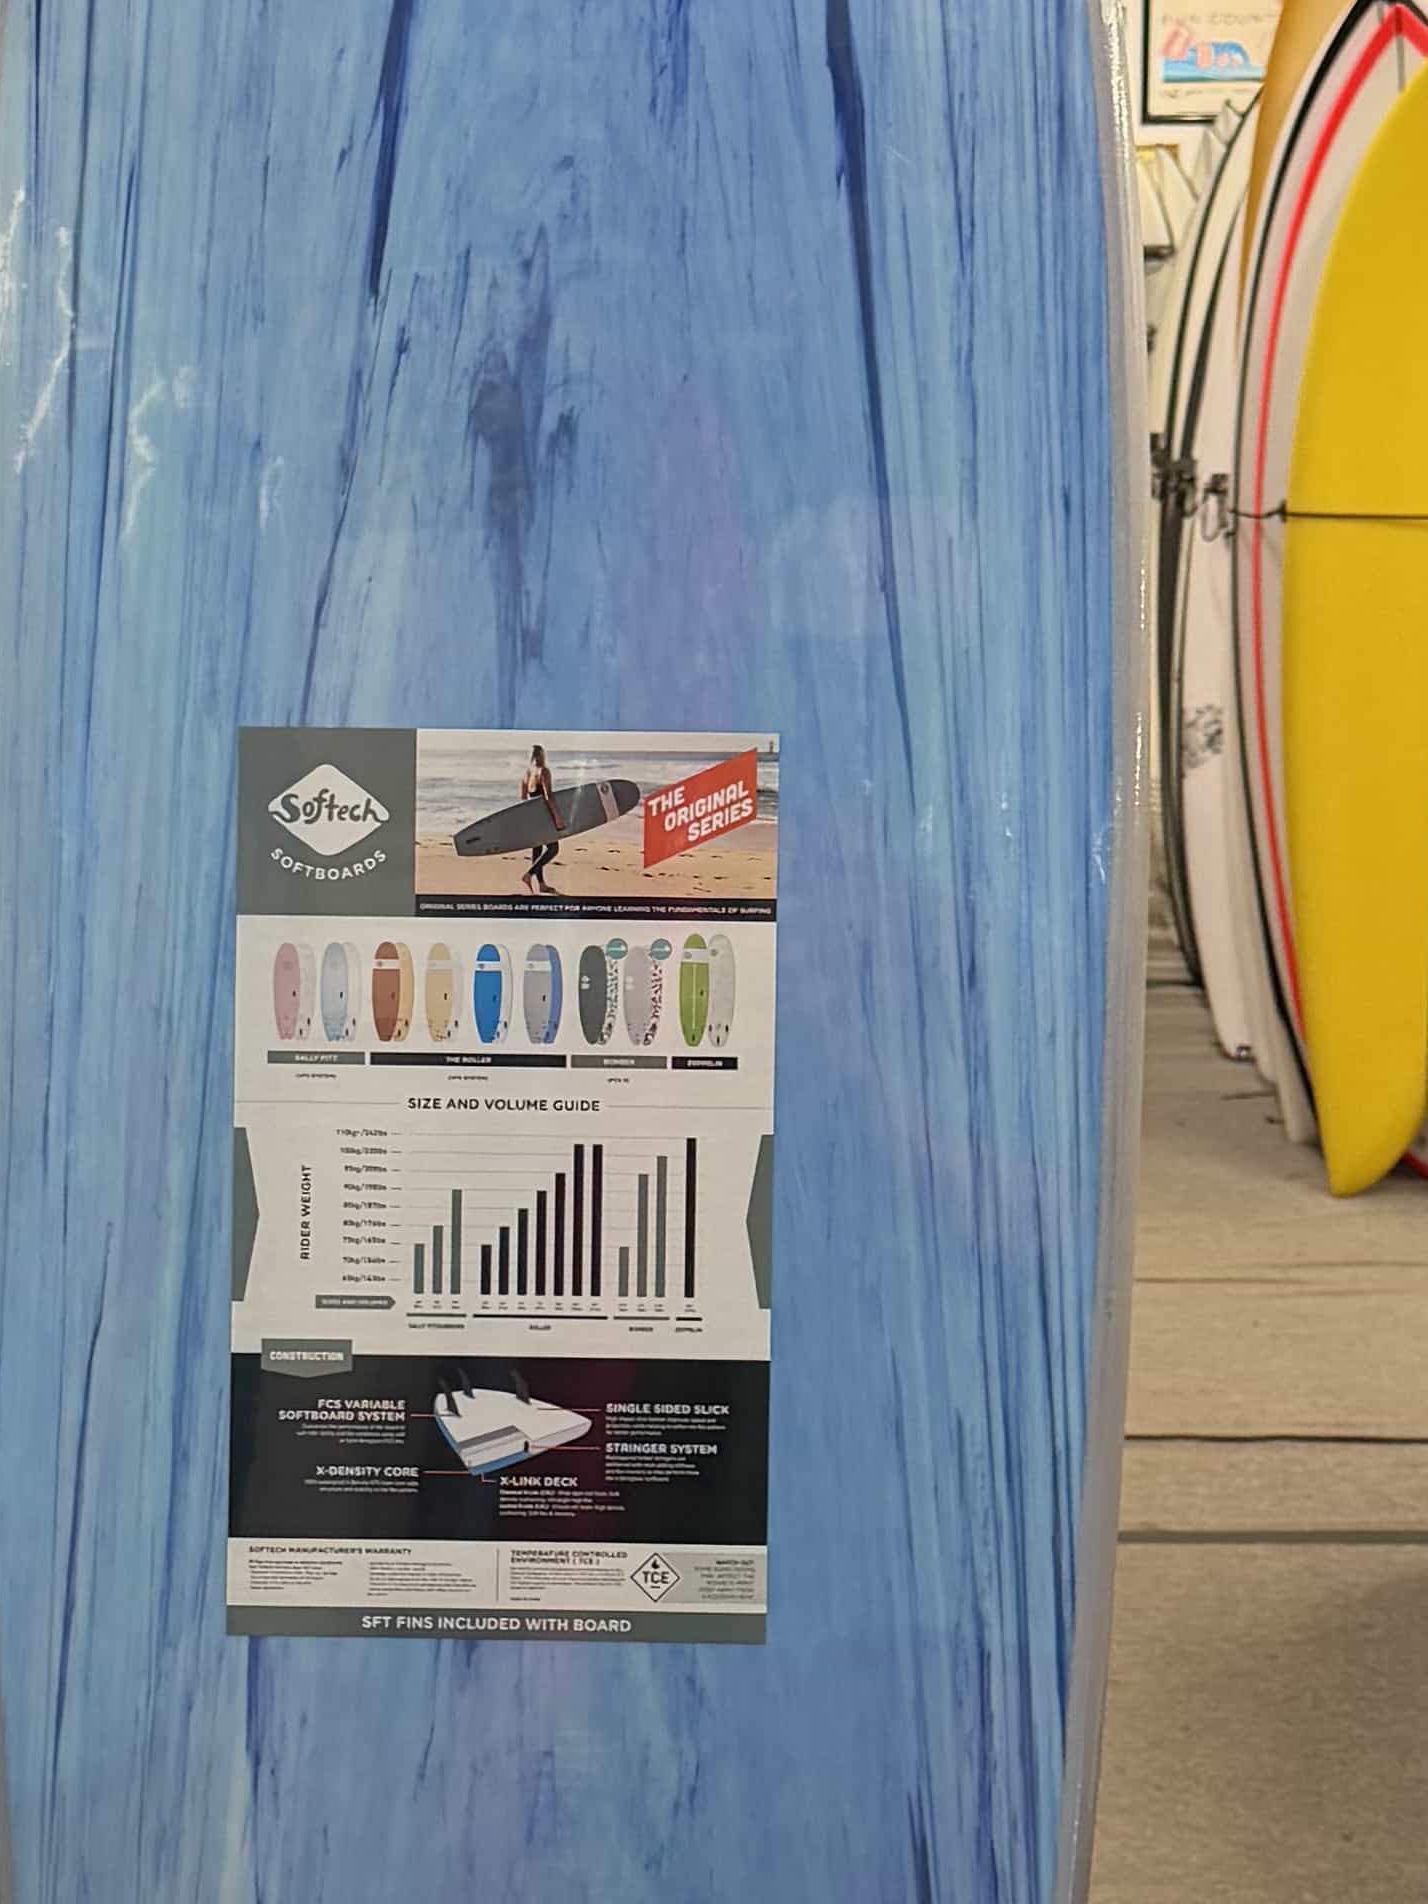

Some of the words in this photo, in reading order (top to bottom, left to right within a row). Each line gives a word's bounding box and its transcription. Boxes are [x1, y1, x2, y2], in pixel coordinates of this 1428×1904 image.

[270, 788, 382, 824] Softech
[647, 785, 687, 818] THE
[663, 781, 750, 833] ORIGINAL
[687, 801, 754, 842] SERIES
[270, 847, 388, 881] SOFTBOARDS
[419, 902, 454, 911] ORIGINAL
[456, 903, 482, 911] SERIES
[483, 903, 513, 911] BOARDS
[514, 904, 529, 912] ARE
[531, 904, 563, 912] PERFECT
[652, 905, 667, 913] THE
[408, 1097, 443, 1110] SIZE
[447, 1098, 479, 1111] AND
[484, 1099, 548, 1111] VOLUME
[552, 1099, 601, 1112] GUIDE
[300, 1164, 312, 1219] WEIGHT
[300, 1222, 312, 1260] RIDER
[269, 1350, 344, 1362] CONSTRUCTION
[317, 1398, 342, 1410] FCS
[344, 1399, 405, 1410] VARIABLE
[605, 1403, 651, 1415] SINGLE
[653, 1404, 691, 1415] SIDED
[693, 1404, 730, 1416] SLICK
[278, 1410, 355, 1421] SOFTBOARD
[357, 1410, 406, 1422] SYSTEM
[605, 1442, 667, 1454] STRINGER
[670, 1444, 718, 1455] SYSTEM
[315, 1465, 381, 1477] X-DENSITY
[383, 1466, 419, 1478] CORE
[499, 1476, 542, 1487] X-LINK
[543, 1476, 578, 1487] DECK
[249, 1546, 287, 1554] SOFTECH
[364, 1547, 412, 1556] WARRANTY
[510, 1549, 570, 1558] TEMPERATURE
[572, 1550, 628, 1560] CONTROLLED
[510, 1556, 572, 1565] ENVIRONMENT
[641, 1571, 670, 1585] TCE
[361, 1615, 393, 1629] SFT
[396, 1616, 434, 1630] FINS
[437, 1616, 520, 1631] INCLUDED
[525, 1618, 569, 1632] WITH
[573, 1619, 632, 1633] BOARD
